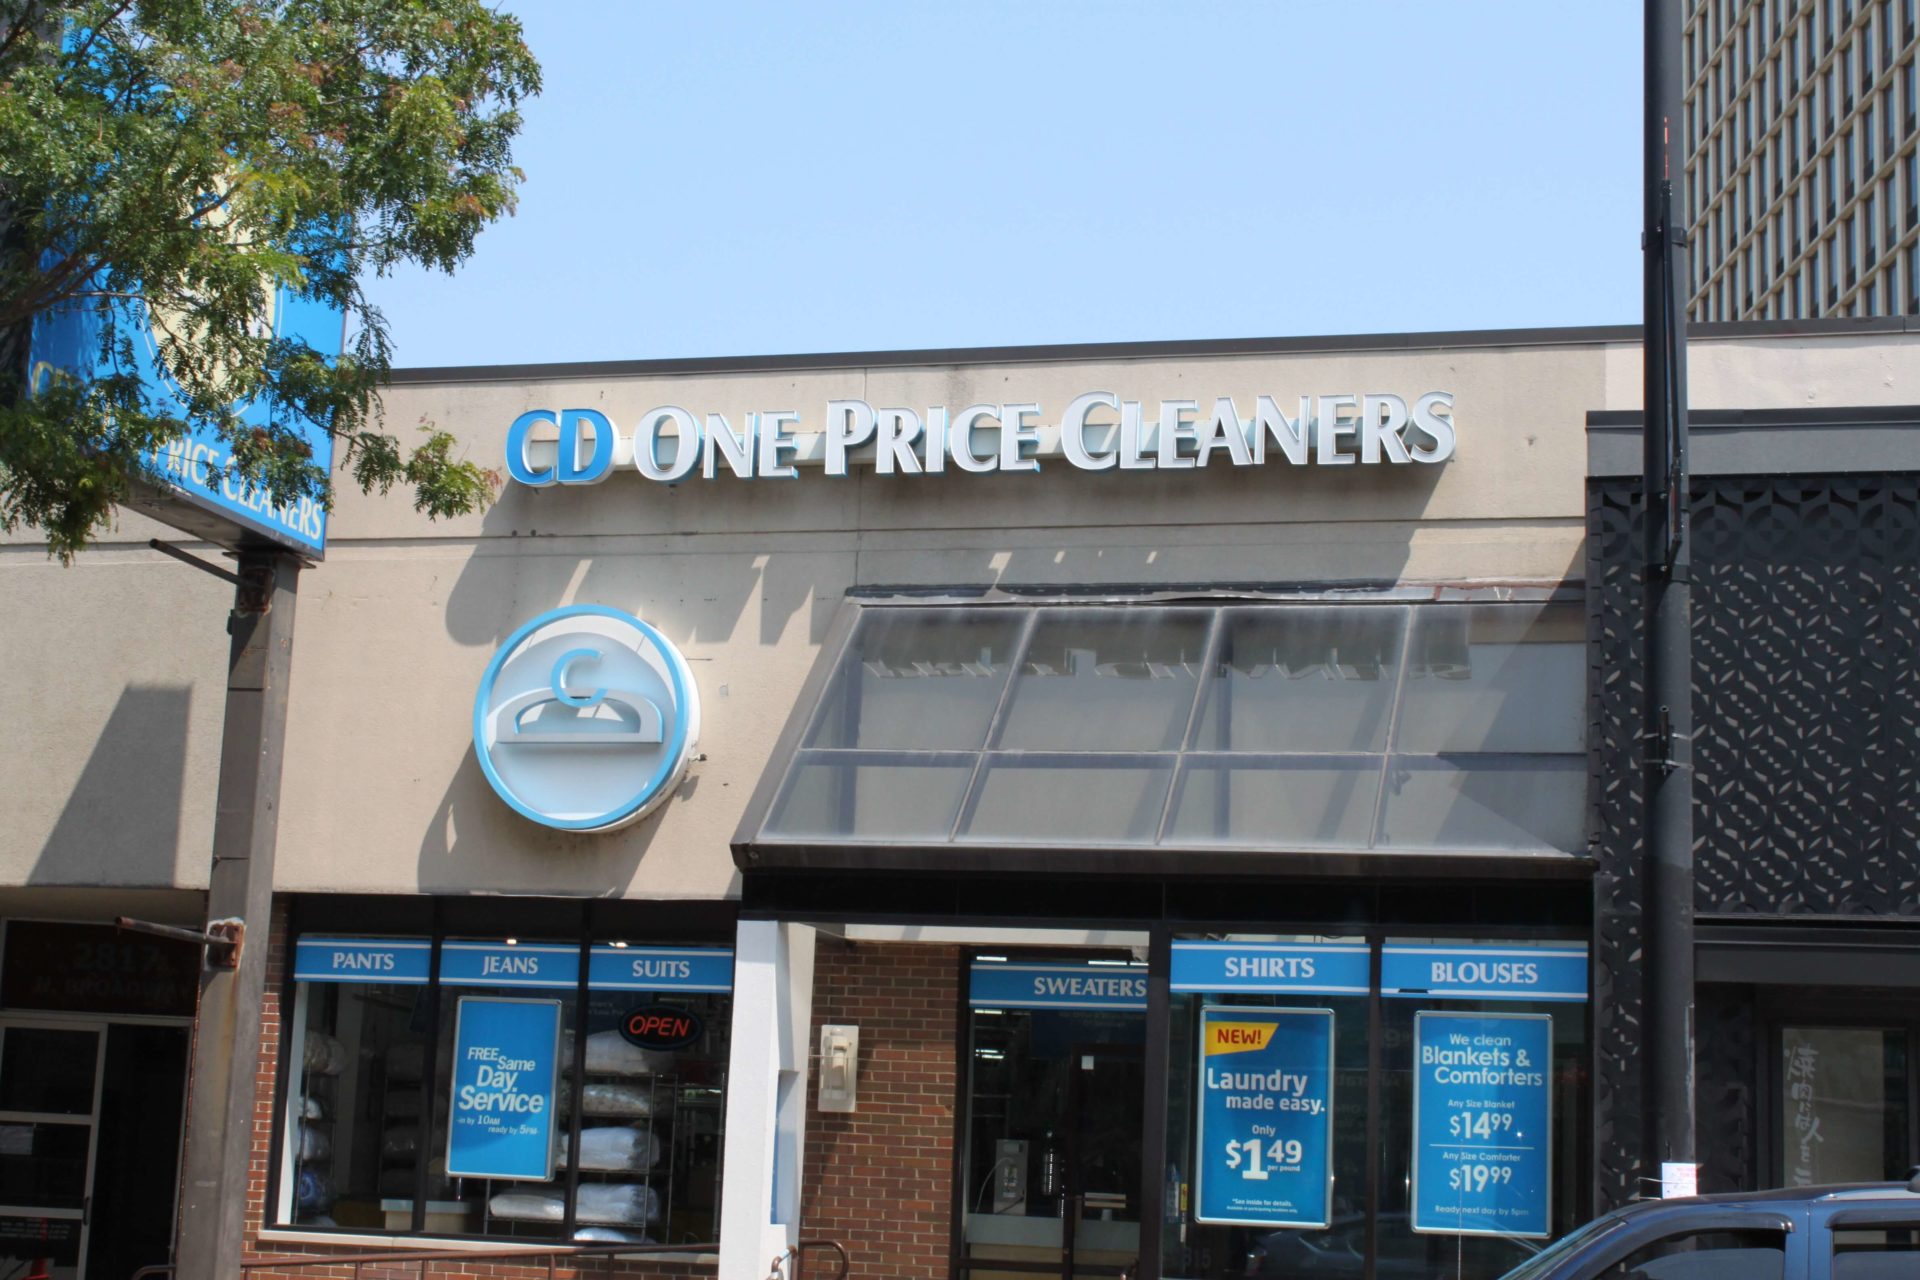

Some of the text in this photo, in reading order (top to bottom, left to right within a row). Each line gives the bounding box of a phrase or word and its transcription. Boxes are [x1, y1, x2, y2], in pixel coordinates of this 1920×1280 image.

[505, 390, 1456, 486] CD ONE PRICE CLEANERS
[332, 951, 395, 971] PANTS
[482, 955, 539, 975] JEANS
[632, 959, 691, 979] SUITS
[1224, 956, 1316, 978] SHIRTS
[1430, 961, 1539, 984] BLOUSES
[1033, 976, 1147, 998] SWEATERS
[628, 1015, 691, 1038] OPEN
[1216, 1027, 1262, 1045] NEW!
[1449, 1033, 1512, 1046] We clean
[467, 1046, 500, 1061] FREE
[496, 1055, 537, 1072] Same
[1422, 1046, 1531, 1068] Blankets &
[1207, 1067, 1309, 1097] Laundry
[1434, 1066, 1543, 1087] Comforters
[458, 1085, 545, 1114] Service
[1225, 1094, 1326, 1116] made easy.
[1447, 1099, 1516, 1110] Any Size Blanket
[477, 1114, 501, 1125] 10AM
[488, 1126, 508, 1136] ready
[509, 1126, 519, 1137] by
[1251, 1124, 1277, 1138] Only
[1442, 1152, 1521, 1162] Any Size Comforter
[1267, 1165, 1278, 1173] per
[1246, 1199, 1263, 1207] inside
[1435, 1205, 1461, 1215] Ready
[1481, 1207, 1497, 1216] day
[1498, 1208, 1510, 1217] by
[1511, 1208, 1529, 1217] 5pm
